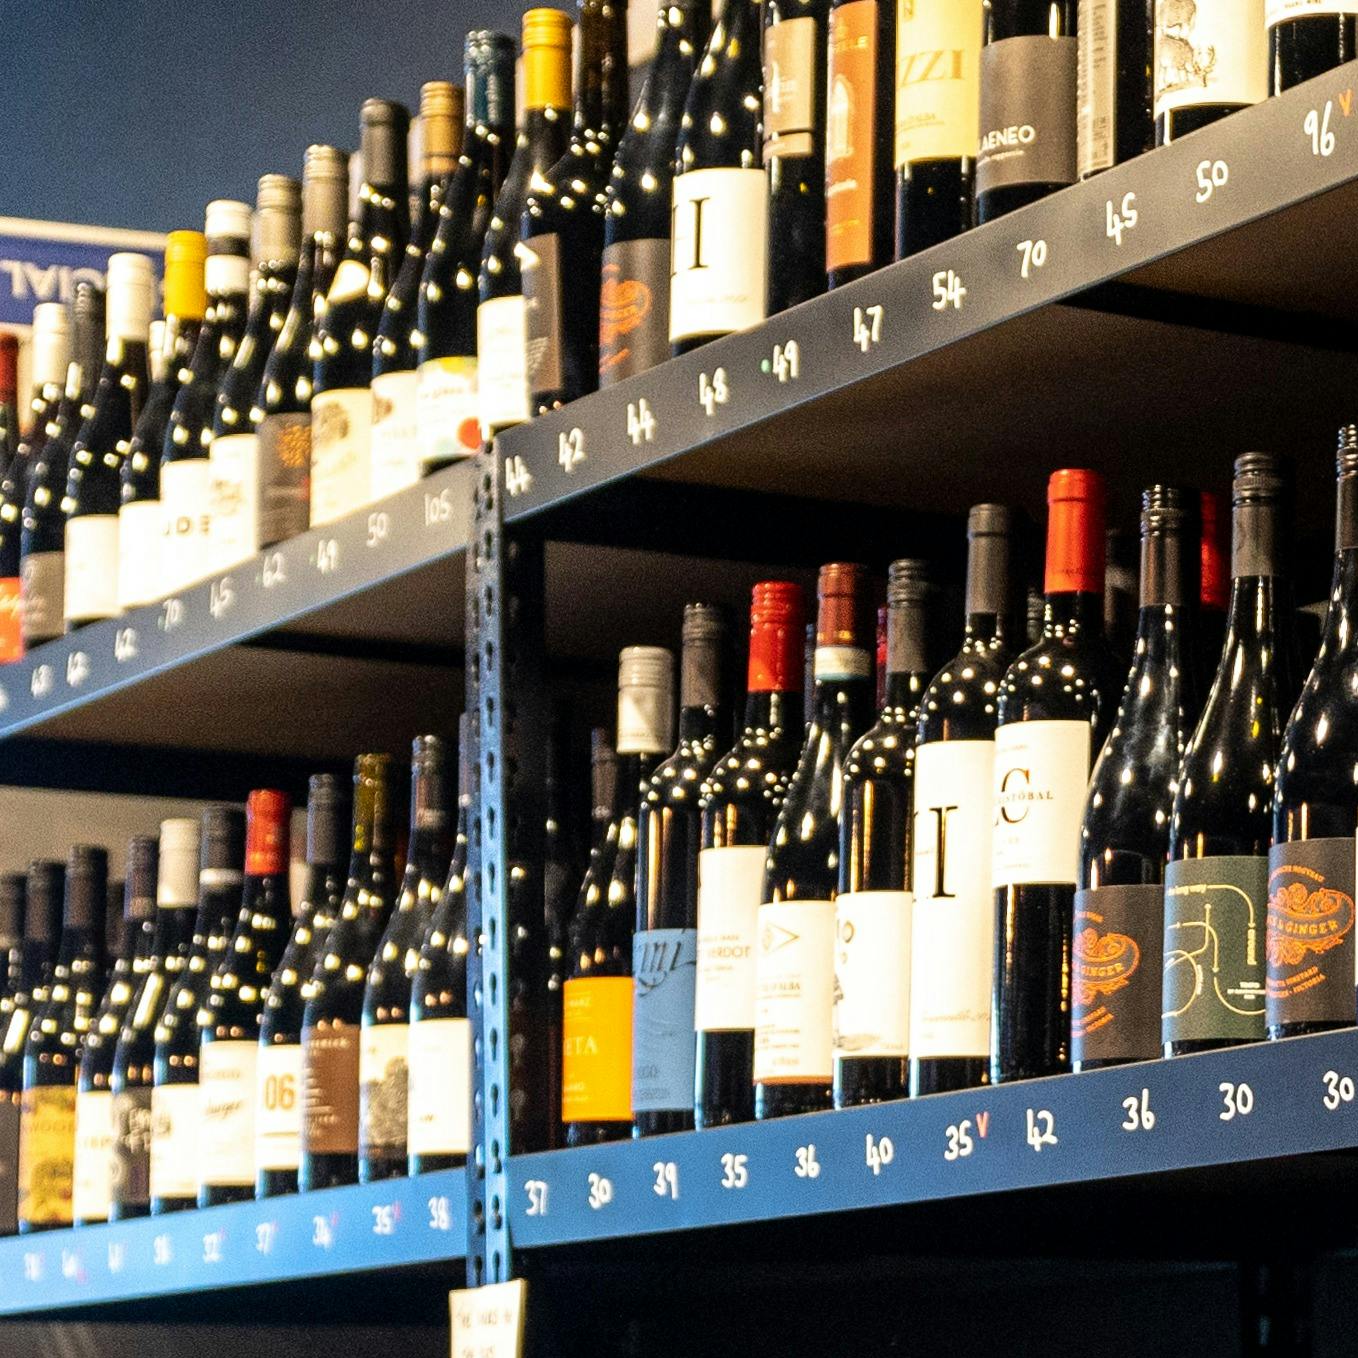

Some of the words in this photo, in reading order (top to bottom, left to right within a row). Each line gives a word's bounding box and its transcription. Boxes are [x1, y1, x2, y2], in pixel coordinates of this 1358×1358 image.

[1304, 101, 1336, 157] 96
[1196, 160, 1228, 203] 50
[1106, 191, 1138, 245] 45
[1017, 239, 1047, 278] 70
[932, 269, 967, 310] 54
[853, 305, 882, 352] 47
[773, 340, 799, 382] 49
[699, 367, 729, 415] 48
[627, 398, 656, 445] 44
[559, 429, 586, 472] 42
[506, 454, 531, 495] 44
[1122, 1089, 1155, 1131] 36
[1218, 1082, 1254, 1121] 30
[1322, 1070, 1355, 1110] 30
[944, 1123, 974, 1160] 35
[1027, 1109, 1058, 1151] 42
[720, 1154, 748, 1187] 35
[794, 1144, 820, 1178] 36
[865, 1135, 894, 1174] 40
[524, 1181, 548, 1216] 37
[588, 1174, 613, 1209] 30
[653, 1162, 679, 1199] 39
